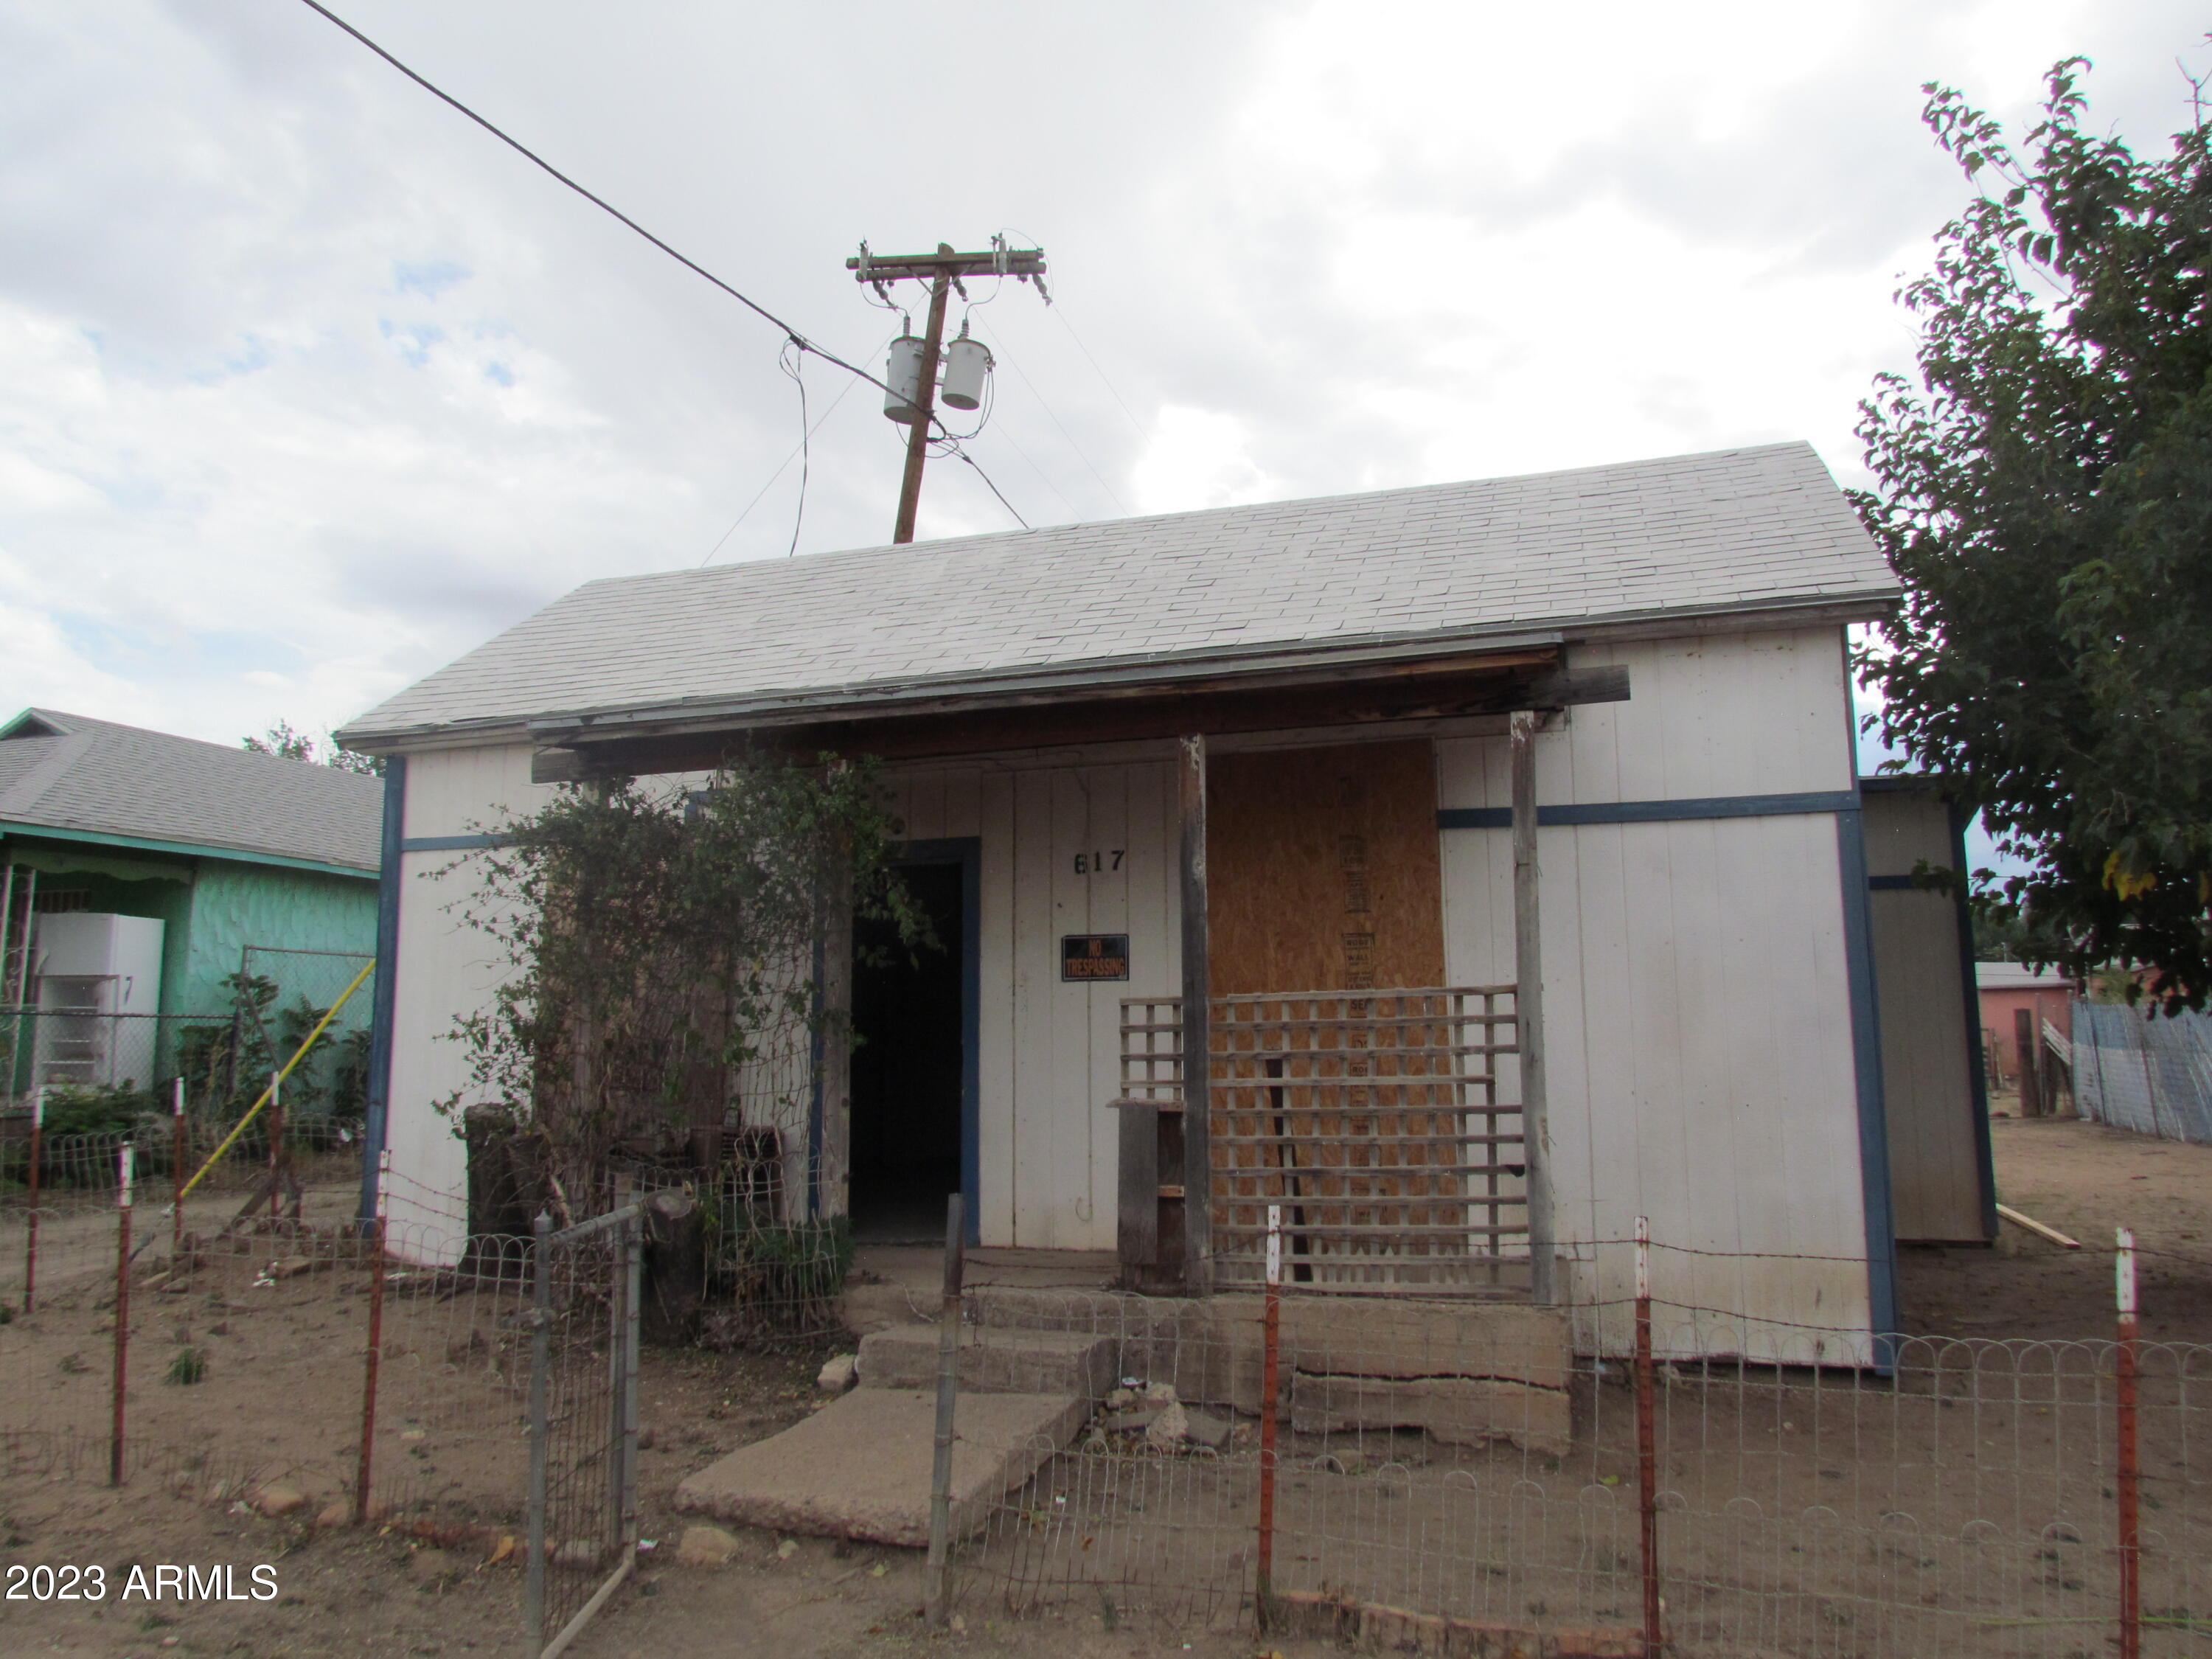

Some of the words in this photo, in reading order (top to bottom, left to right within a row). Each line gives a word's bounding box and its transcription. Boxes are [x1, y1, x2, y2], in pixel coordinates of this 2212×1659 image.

[1074, 849, 1124, 874] 617
[1088, 939, 1102, 957] NO
[1065, 958, 1124, 976] TRESPASSING
